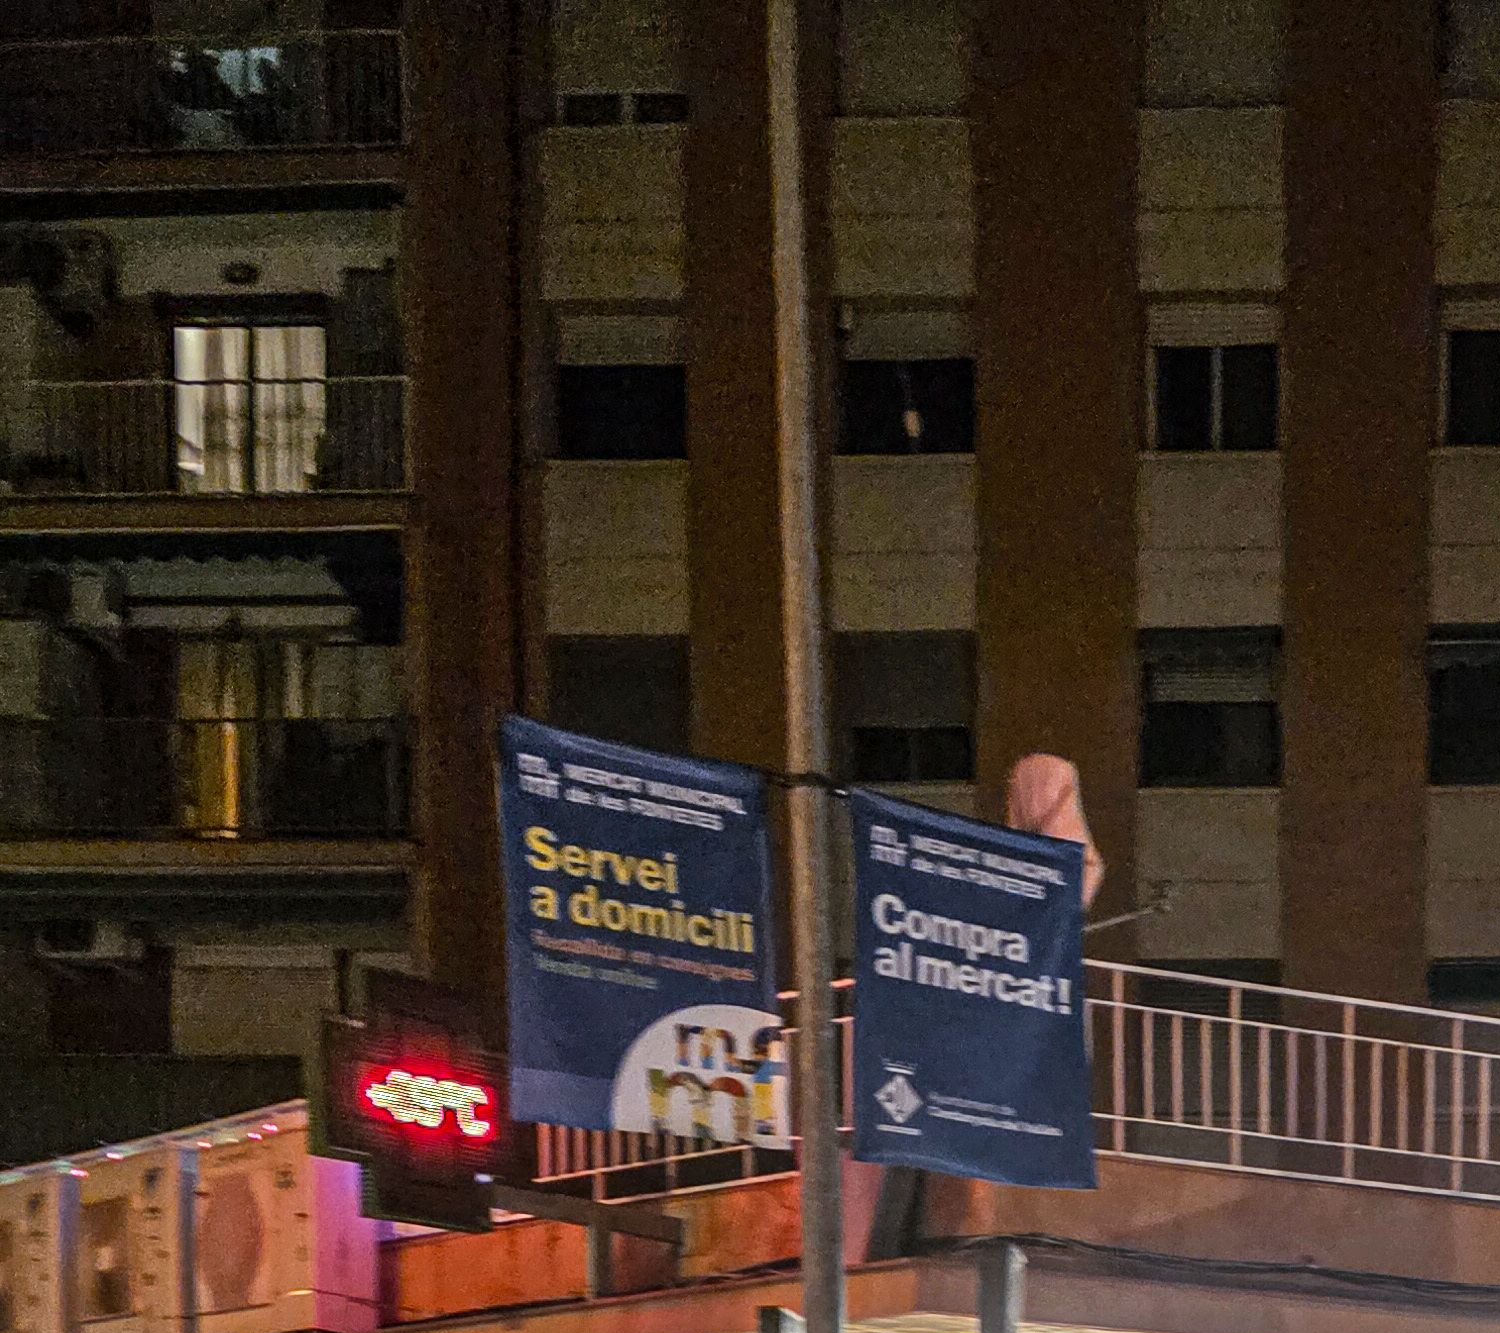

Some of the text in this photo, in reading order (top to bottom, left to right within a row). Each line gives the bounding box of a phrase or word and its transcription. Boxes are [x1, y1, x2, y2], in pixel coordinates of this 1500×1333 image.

[525, 827, 678, 894] Servei
[530, 886, 755, 953] a domicili
[872, 894, 1029, 962] Compra
[873, 943, 1072, 1015] al mercat!
